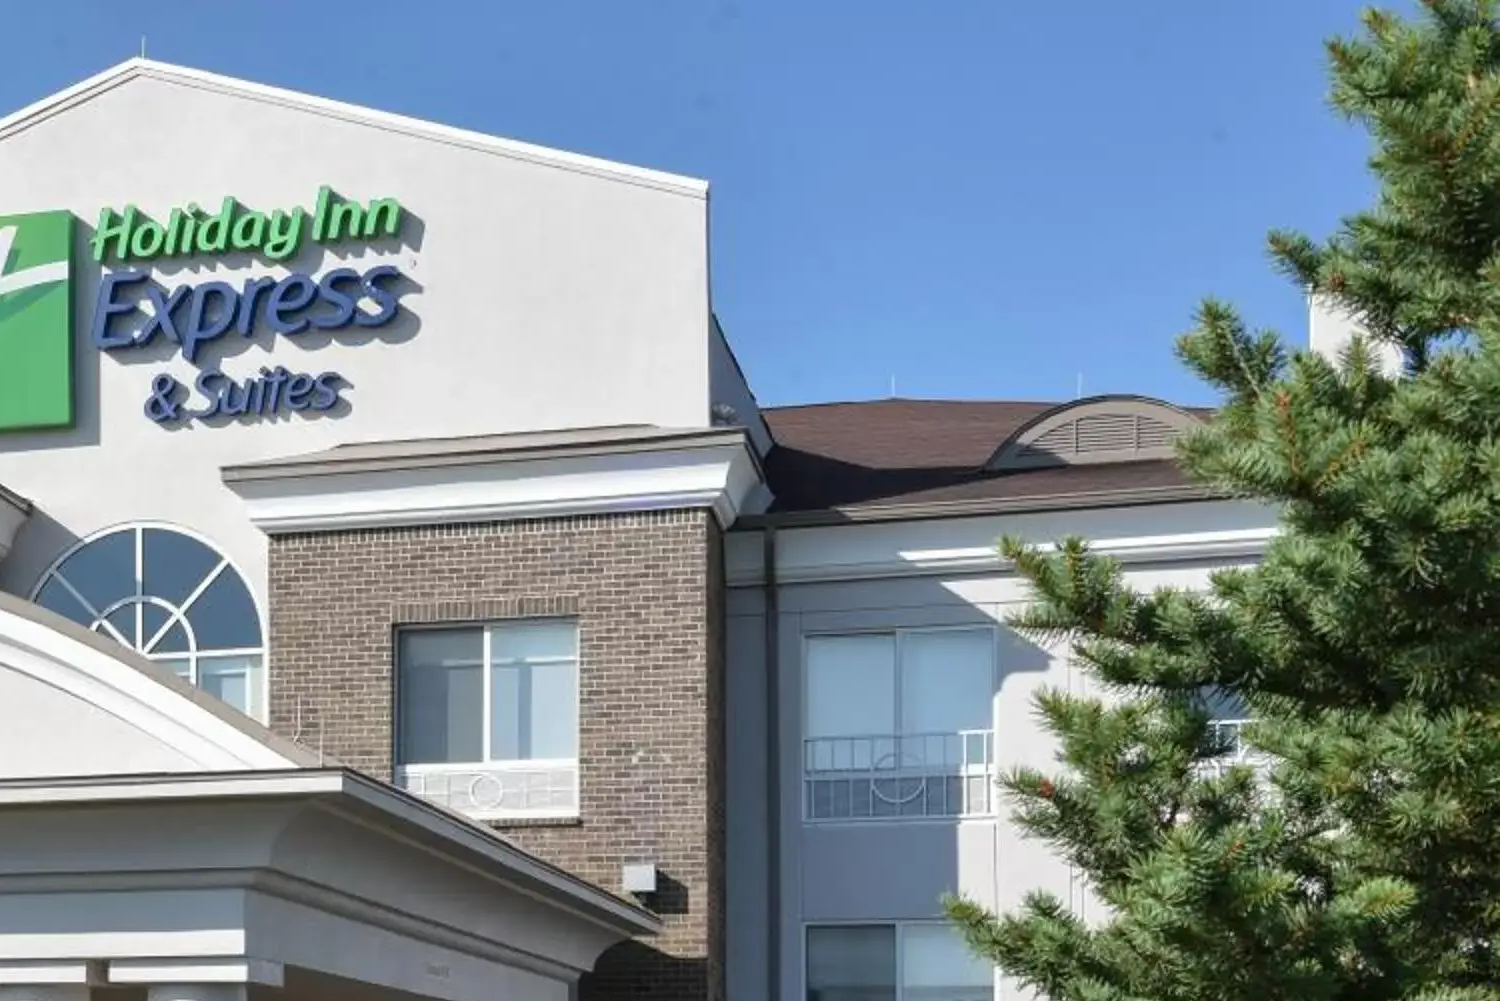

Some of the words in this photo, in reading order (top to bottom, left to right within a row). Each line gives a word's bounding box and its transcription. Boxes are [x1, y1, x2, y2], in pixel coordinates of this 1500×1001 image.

[90, 197, 299, 262] Holiday
[311, 185, 399, 241] Inn
[92, 266, 402, 364] Express
[145, 374, 181, 423] &
[193, 365, 341, 418] Suites
